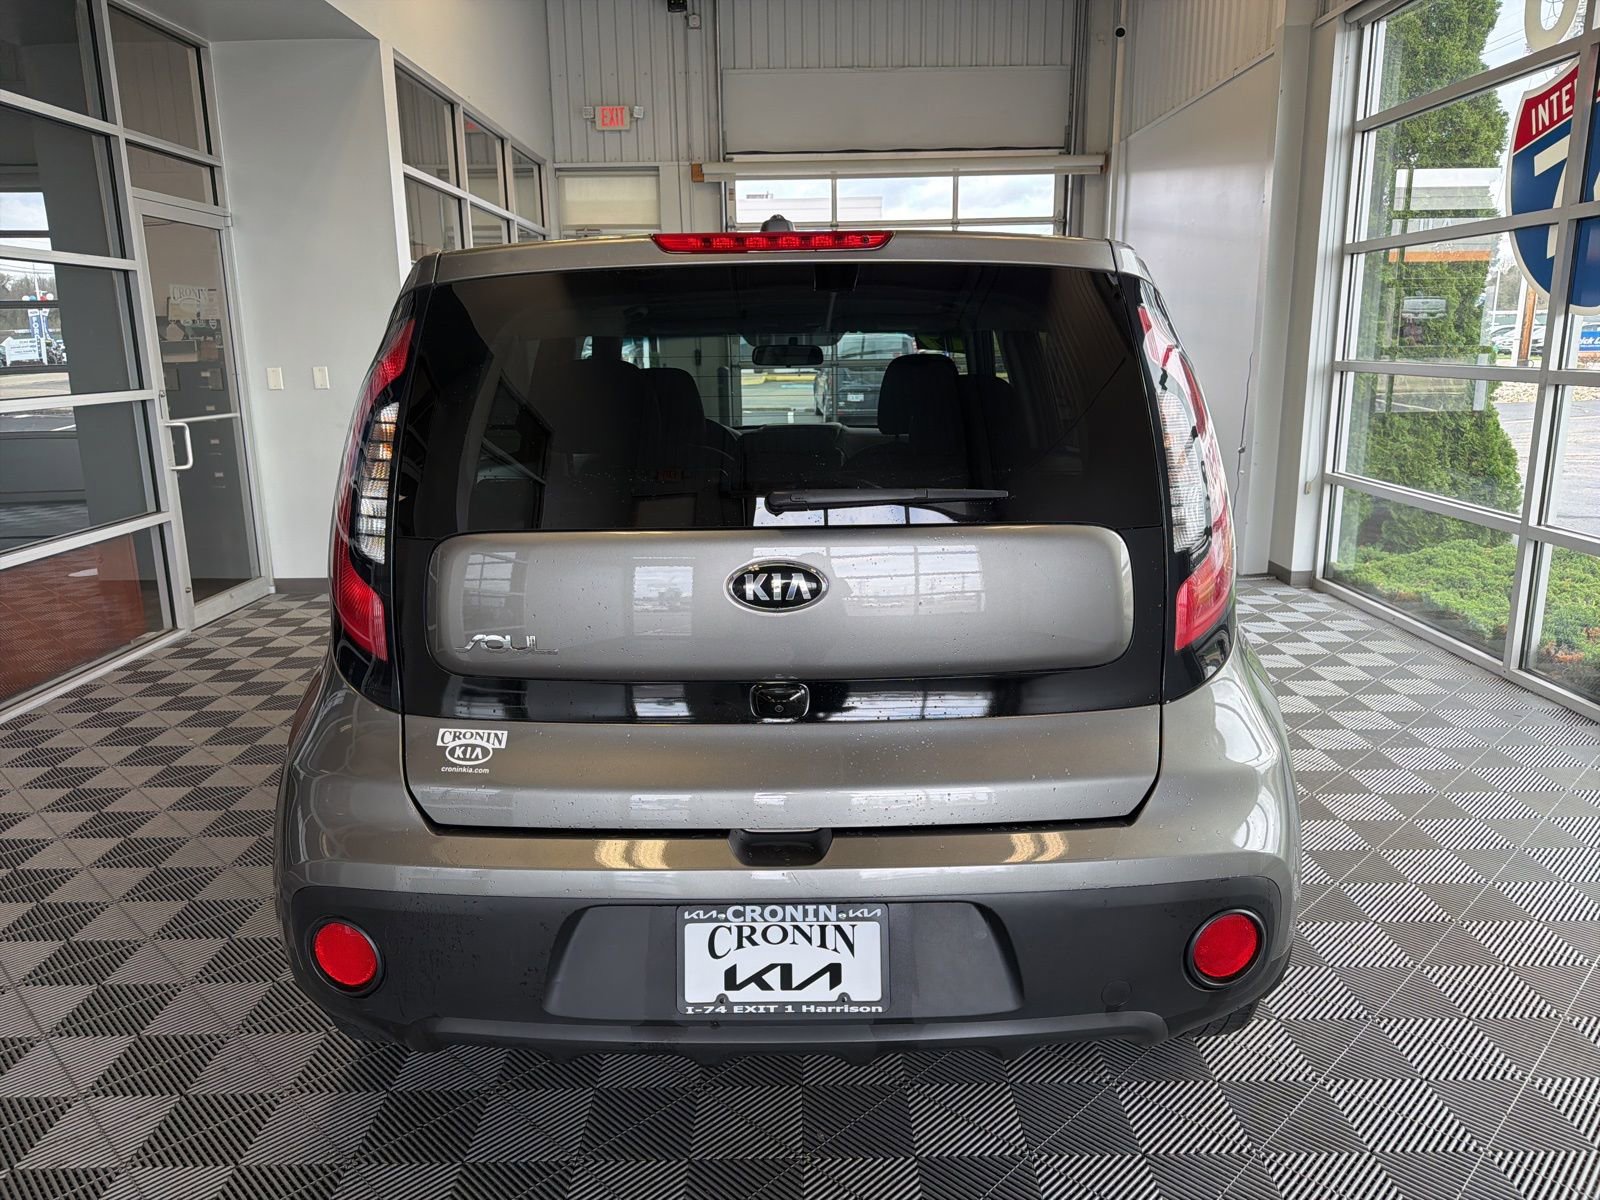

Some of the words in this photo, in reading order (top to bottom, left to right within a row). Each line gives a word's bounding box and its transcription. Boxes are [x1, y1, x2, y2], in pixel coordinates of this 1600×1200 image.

[601, 106, 625, 128] EXIT
[743, 572, 812, 601] KIA
[456, 634, 558, 654] SOUL
[440, 730, 505, 747] CRONIN
[454, 746, 483, 760] KIA
[441, 765, 490, 774] croninkia.com
[684, 909, 718, 920] KIA
[726, 904, 837, 922] CRONIN
[848, 908, 882, 919] KIA
[707, 923, 858, 960] CRONIN
[724, 962, 843, 992] KIA
[685, 1005, 728, 1015] I-74
[733, 1004, 778, 1014] EXIT
[784, 1004, 795, 1014] 1
[801, 1004, 883, 1013] Harrison
